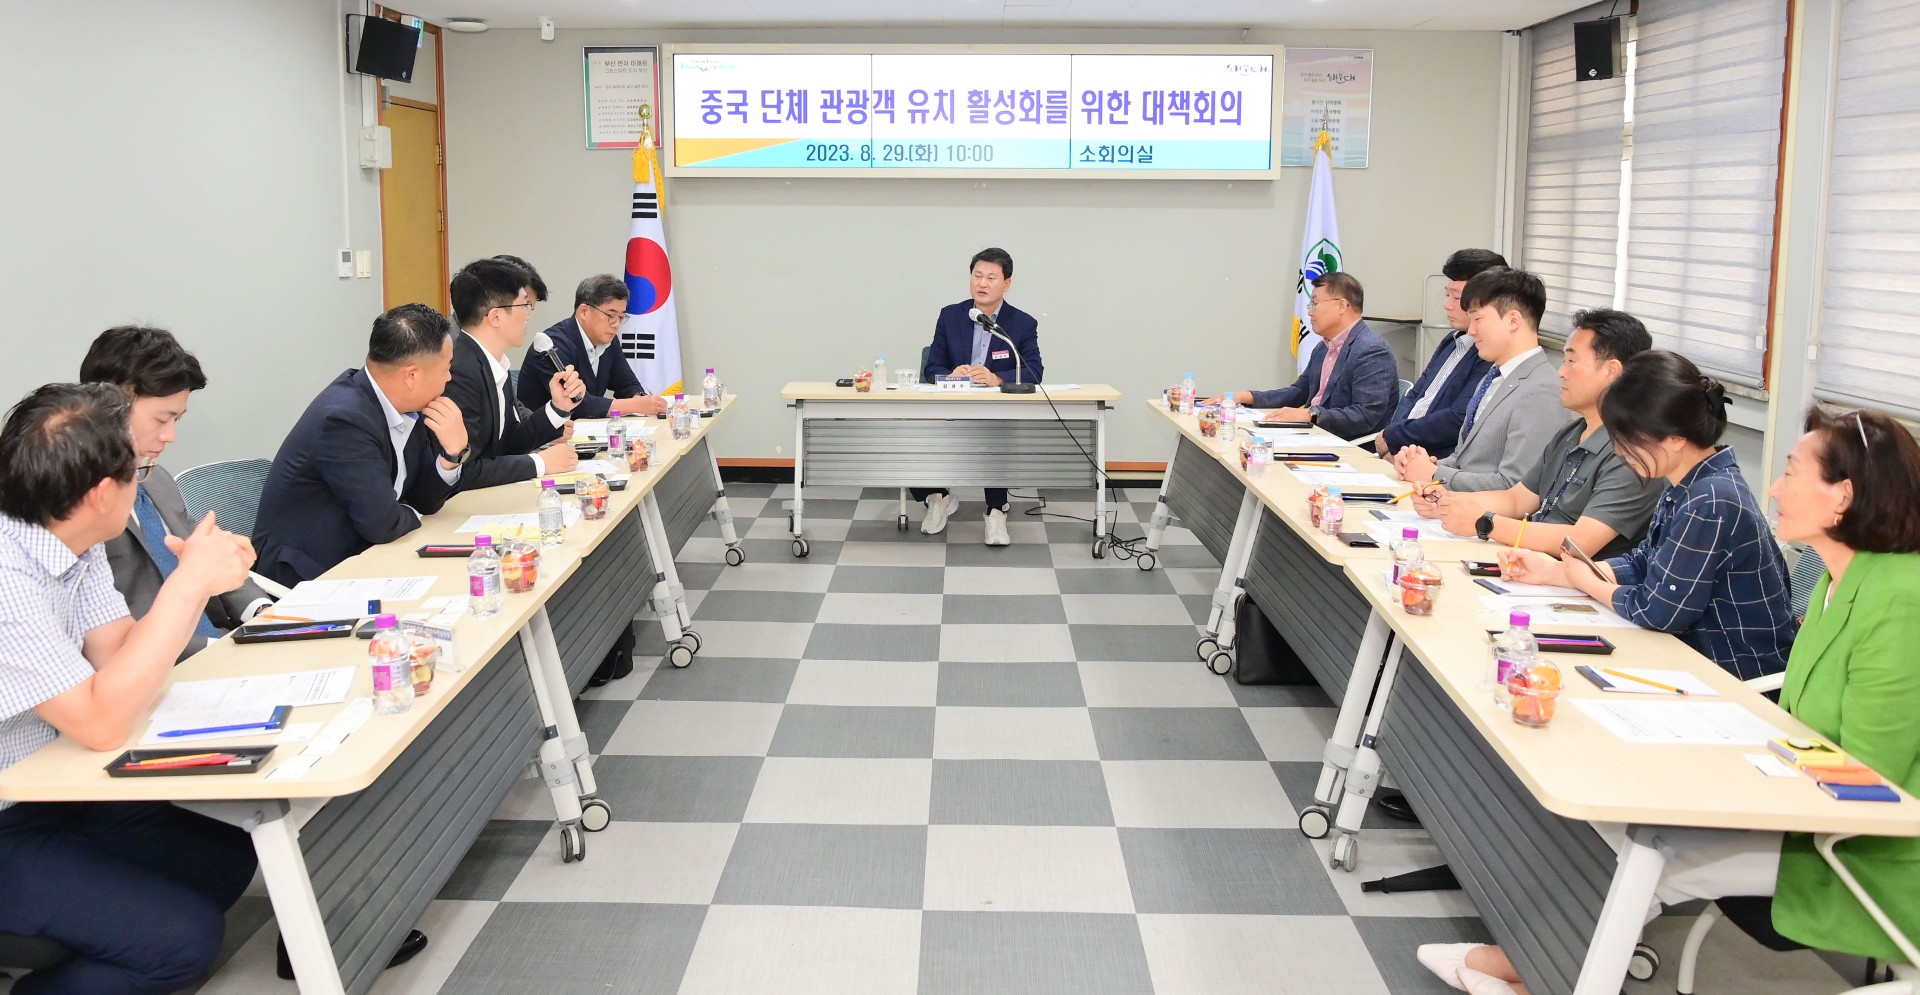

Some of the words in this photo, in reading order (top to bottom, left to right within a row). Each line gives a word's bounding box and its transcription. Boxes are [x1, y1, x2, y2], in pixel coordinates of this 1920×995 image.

[700, 89, 749, 125] 중국
[760, 89, 808, 124] 단체
[819, 89, 896, 125] 관광객
[907, 89, 955, 124] 유치
[967, 89, 1068, 125] 활성화를
[1081, 90, 1131, 125] 위한
[1142, 90, 1242, 126] 대책회의
[806, 144, 854, 162] 2023.
[860, 144, 876, 162] 8.
[946, 144, 994, 162] 10:00
[1079, 144, 1153, 164] 소회의실
